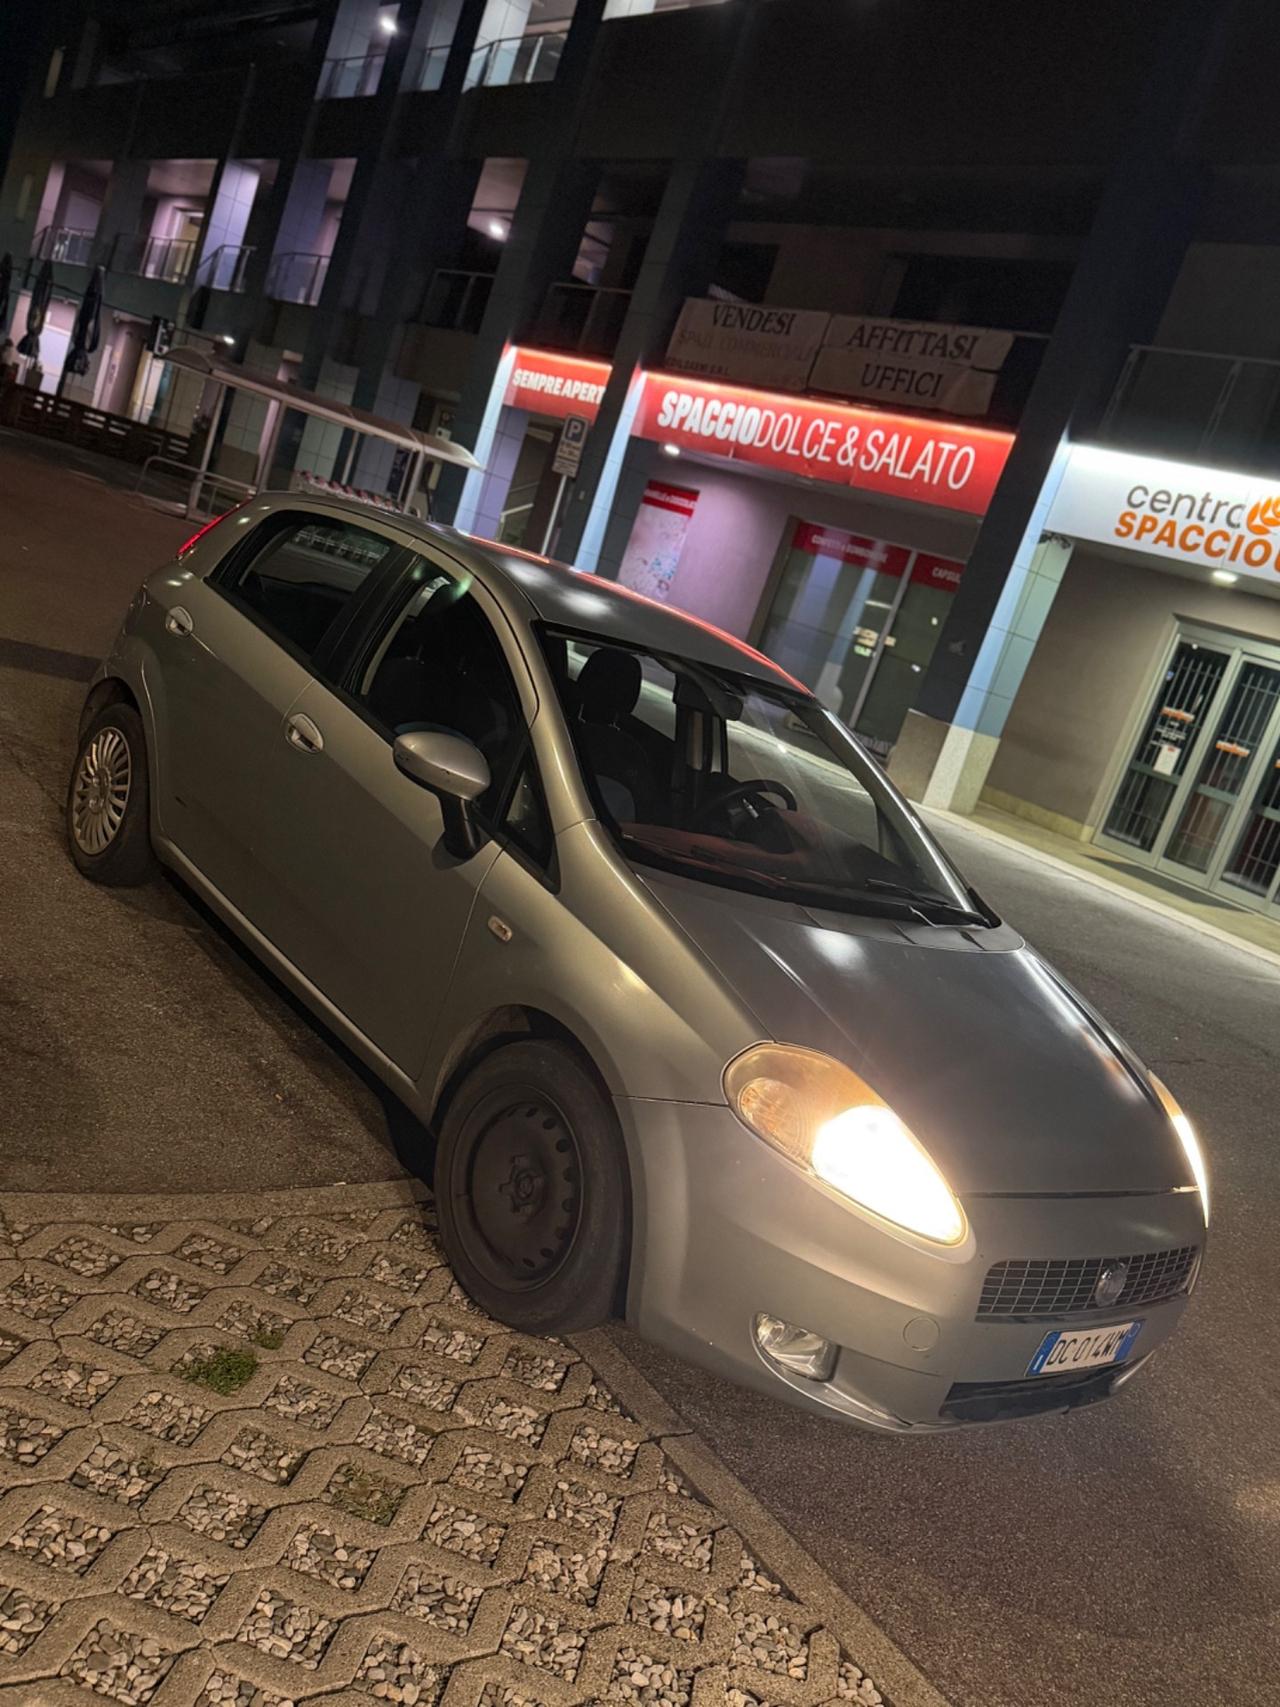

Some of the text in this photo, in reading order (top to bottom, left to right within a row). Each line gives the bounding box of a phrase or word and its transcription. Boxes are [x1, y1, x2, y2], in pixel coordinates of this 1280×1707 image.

[712, 304, 797, 336] VENDESI
[847, 324, 979, 361] AFFITTASI
[512, 368, 607, 405] SEMPRE APERT
[861, 363, 944, 398] UFFICI
[567, 421, 581, 438] P
[859, 430, 976, 490] SALATO
